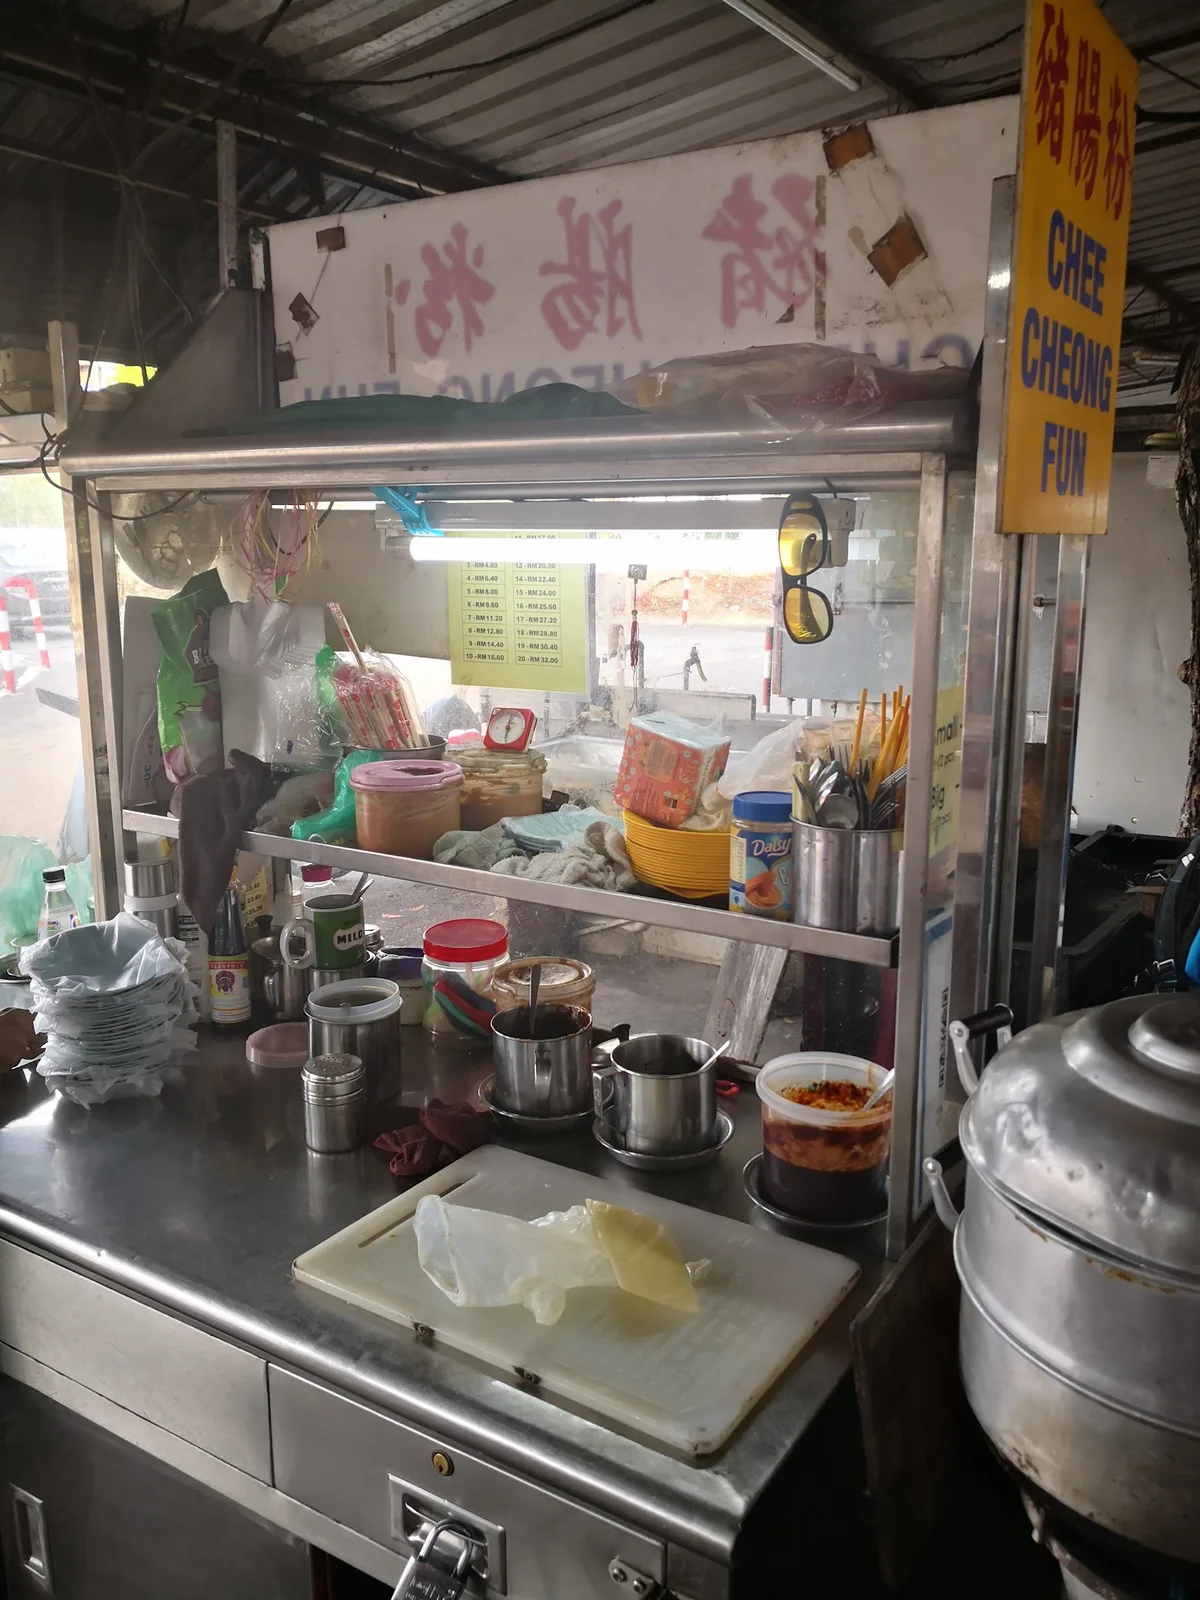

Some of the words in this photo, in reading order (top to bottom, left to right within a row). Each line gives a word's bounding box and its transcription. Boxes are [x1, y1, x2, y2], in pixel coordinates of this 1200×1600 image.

[1047, 209, 1107, 316] CHEE
[1020, 307, 1113, 412] CHEONG
[1040, 421, 1088, 497] FUN
[752, 837, 792, 857] Daisy
[337, 929, 363, 945] MILO
